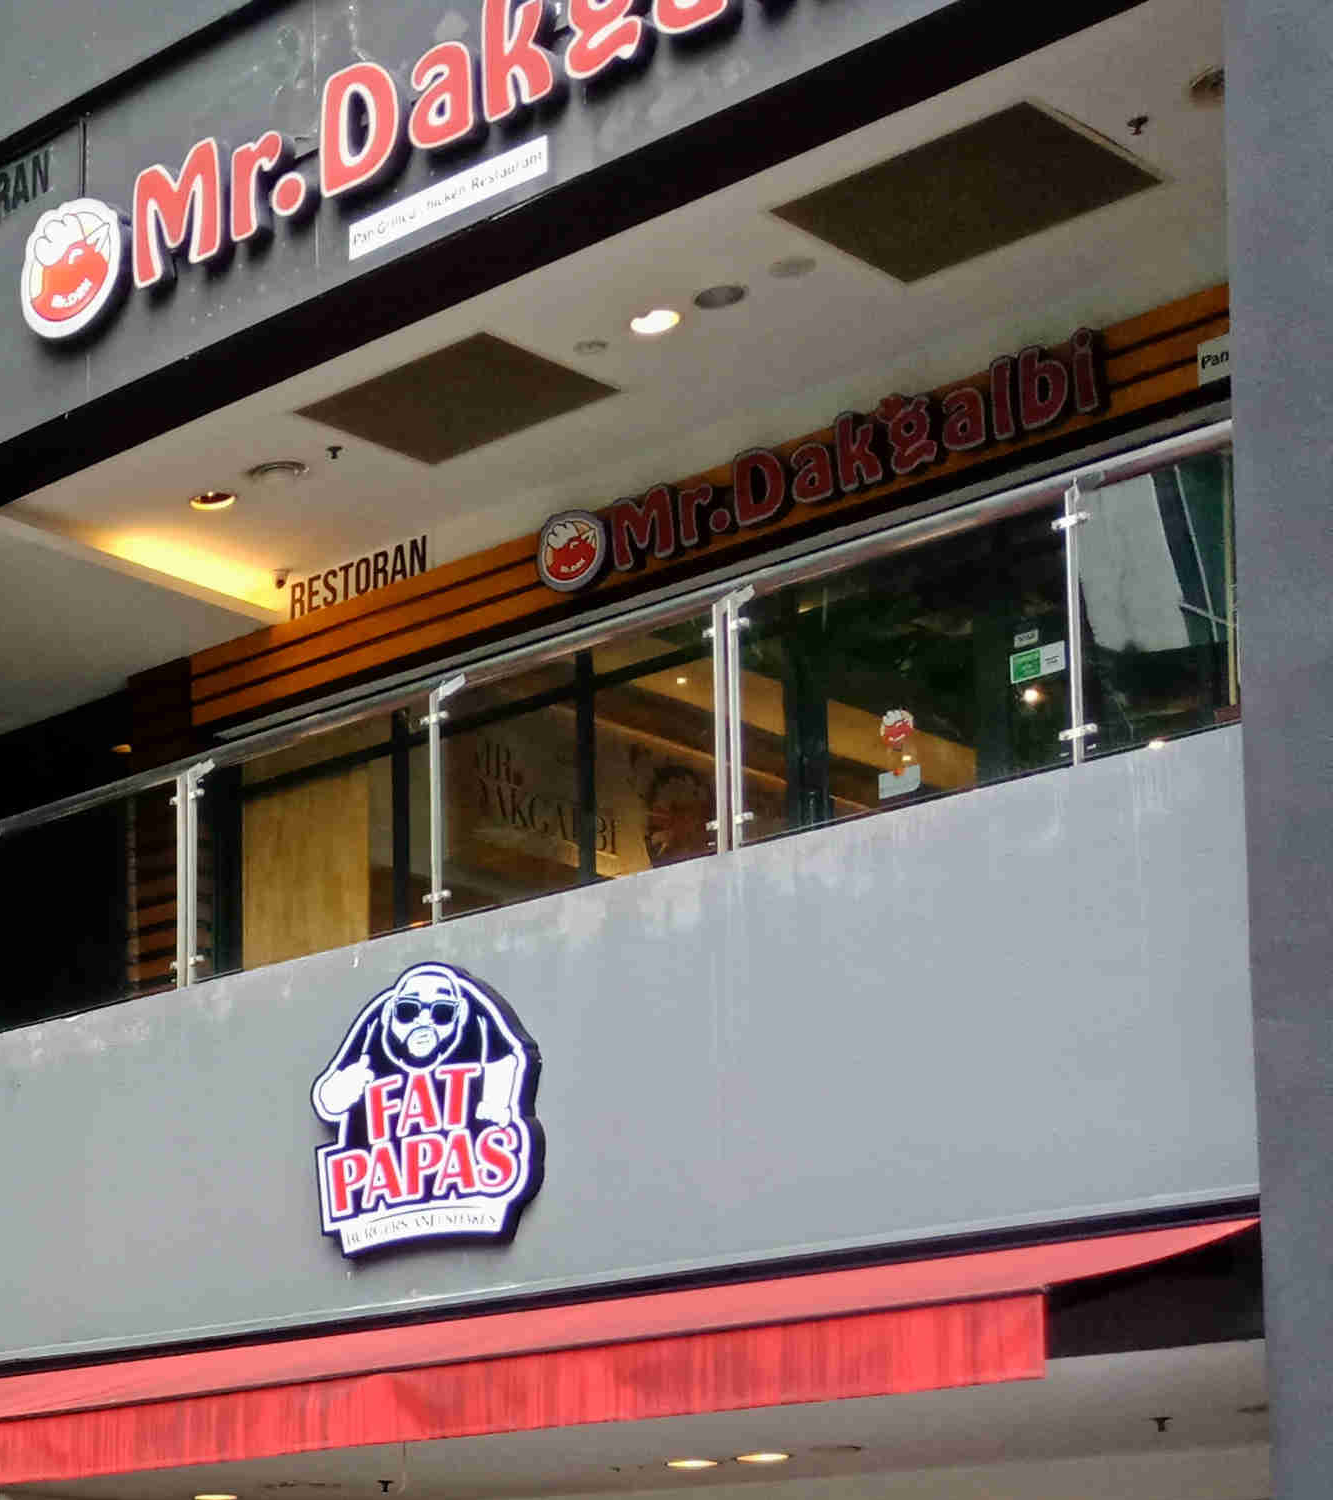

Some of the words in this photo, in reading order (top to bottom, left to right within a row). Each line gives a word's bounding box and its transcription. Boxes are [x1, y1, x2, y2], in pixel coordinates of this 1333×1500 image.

[289, 534, 429, 619] RESTORAN
[367, 1064, 481, 1142] FAT
[329, 1127, 517, 1215] PAPAS
